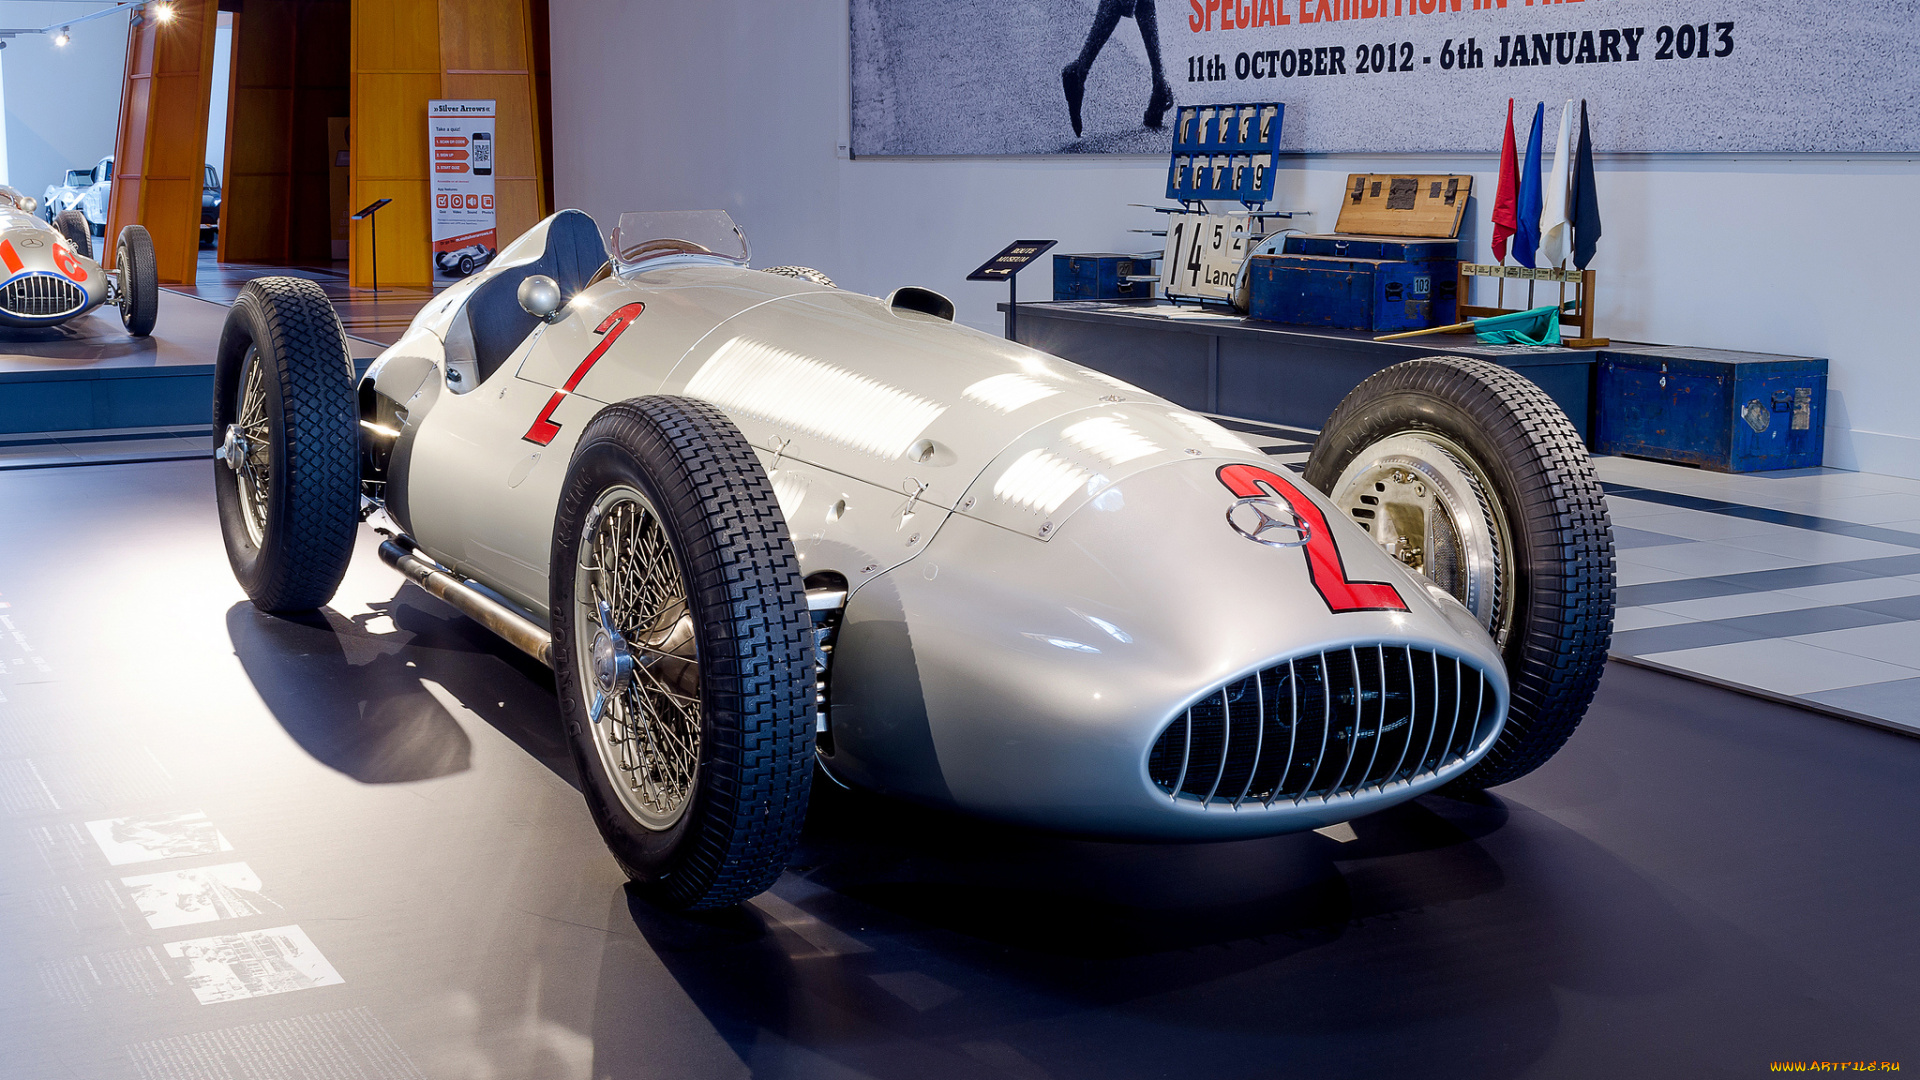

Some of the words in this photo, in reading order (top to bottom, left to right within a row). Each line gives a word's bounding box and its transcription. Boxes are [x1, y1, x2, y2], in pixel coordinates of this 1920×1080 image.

[1188, 54, 1226, 82] 11th
[1235, 46, 1346, 80] OCTOBER
[1355, 42, 1414, 74] 2012
[1423, 56, 1431, 64] -
[1440, 37, 1483, 70] 6th
[1494, 27, 1644, 67] JANUARY
[1655, 22, 1735, 60] 2013
[1255, 164, 1263, 189] 9
[1415, 278, 1430, 292] 103
[521, 301, 646, 447] 2
[1215, 463, 1412, 614] 2
